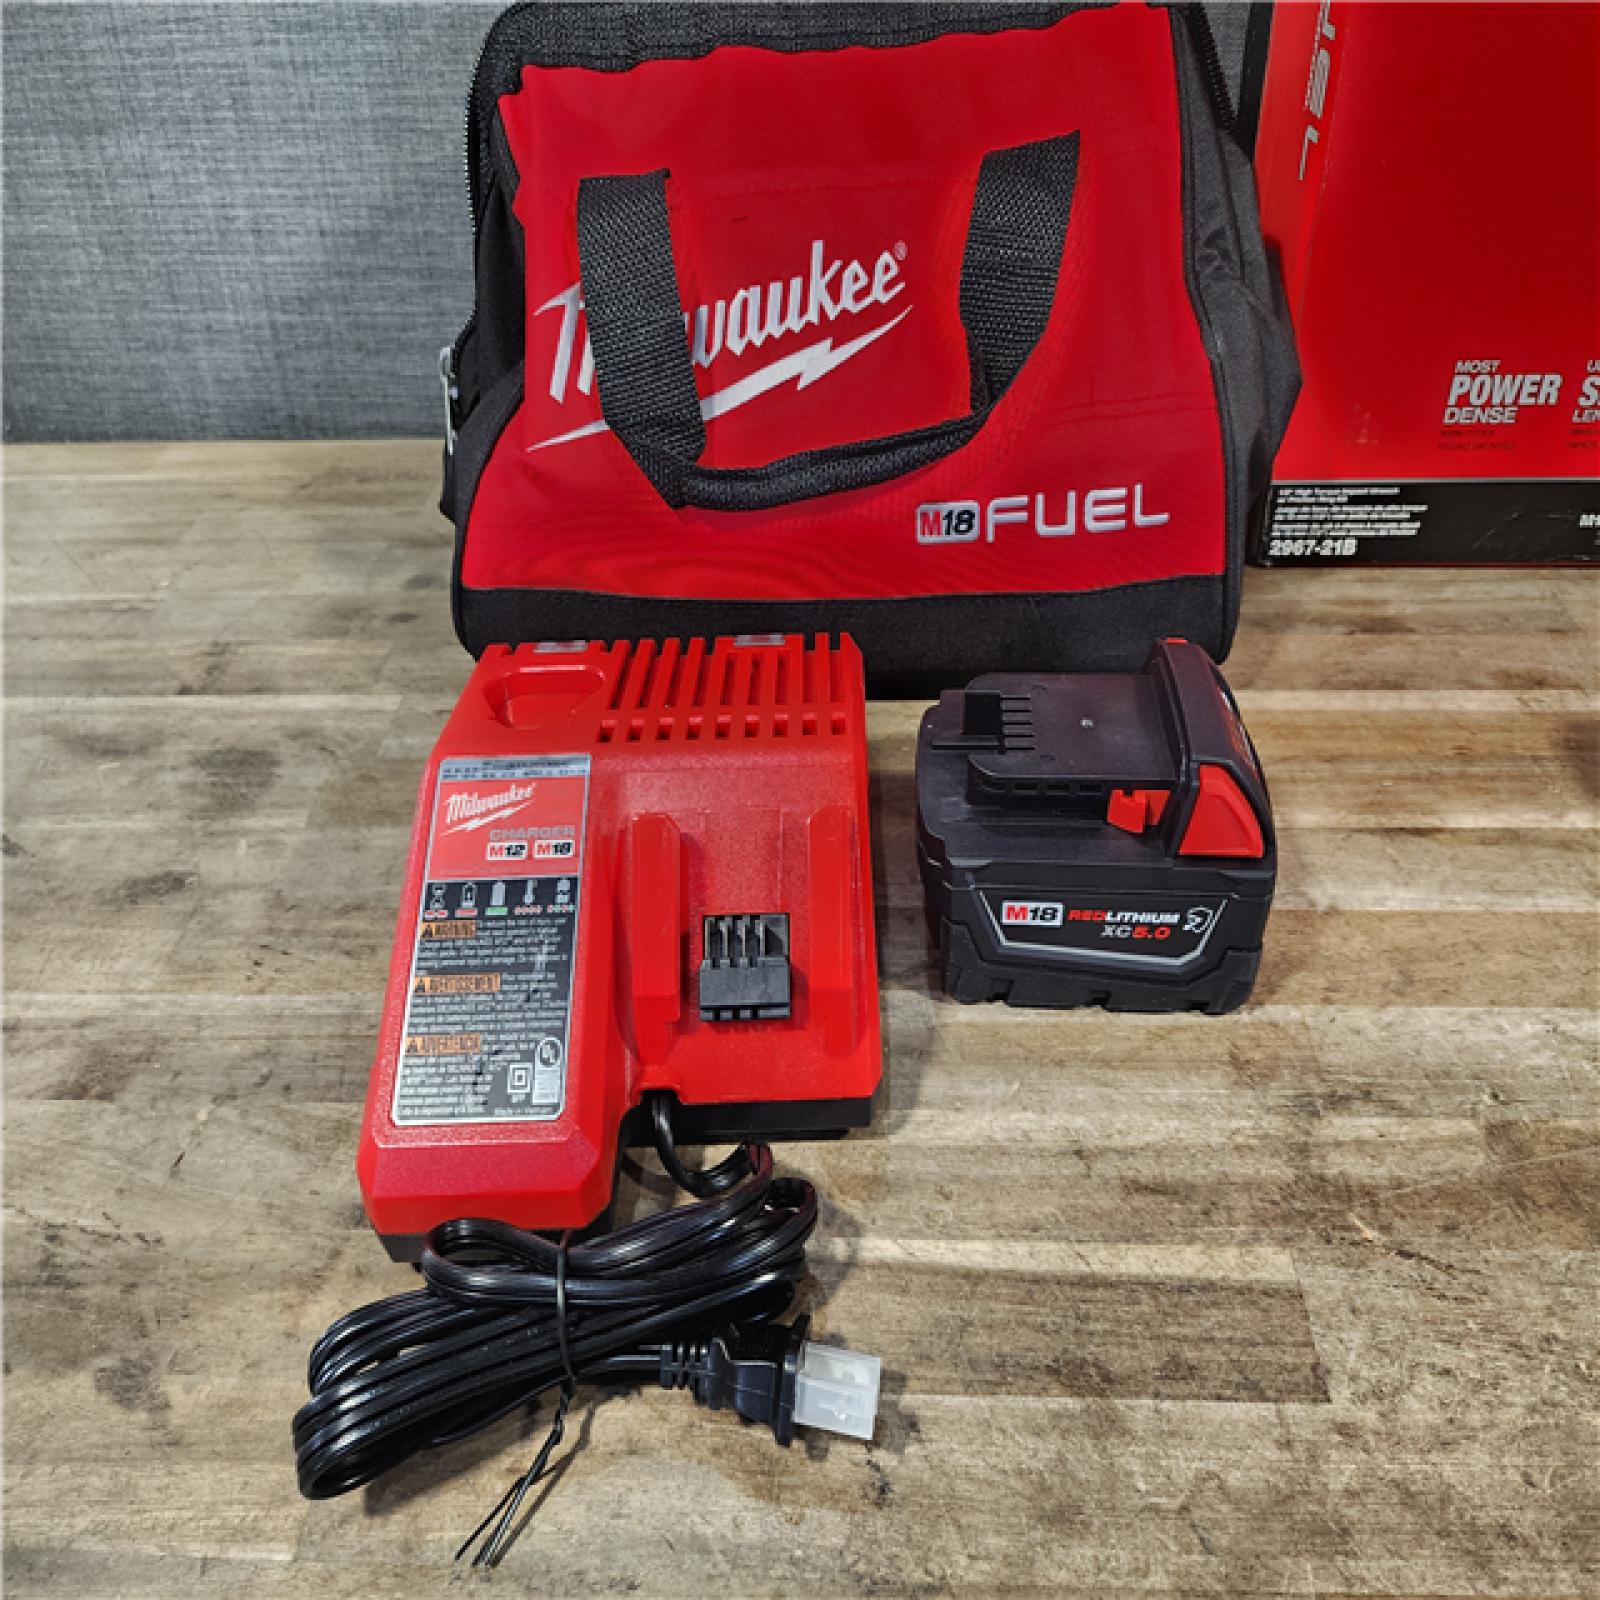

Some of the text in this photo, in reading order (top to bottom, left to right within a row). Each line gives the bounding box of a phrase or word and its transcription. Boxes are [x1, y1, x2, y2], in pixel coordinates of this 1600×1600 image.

[1447, 374, 1563, 406] POWER
[1443, 406, 1519, 424] DENSE
[919, 484, 1170, 542] M18 FUEL
[442, 783, 537, 825] Milwaukee
[536, 841, 572, 856] M18
[1005, 904, 1181, 923] M18 REDLITHIUM
